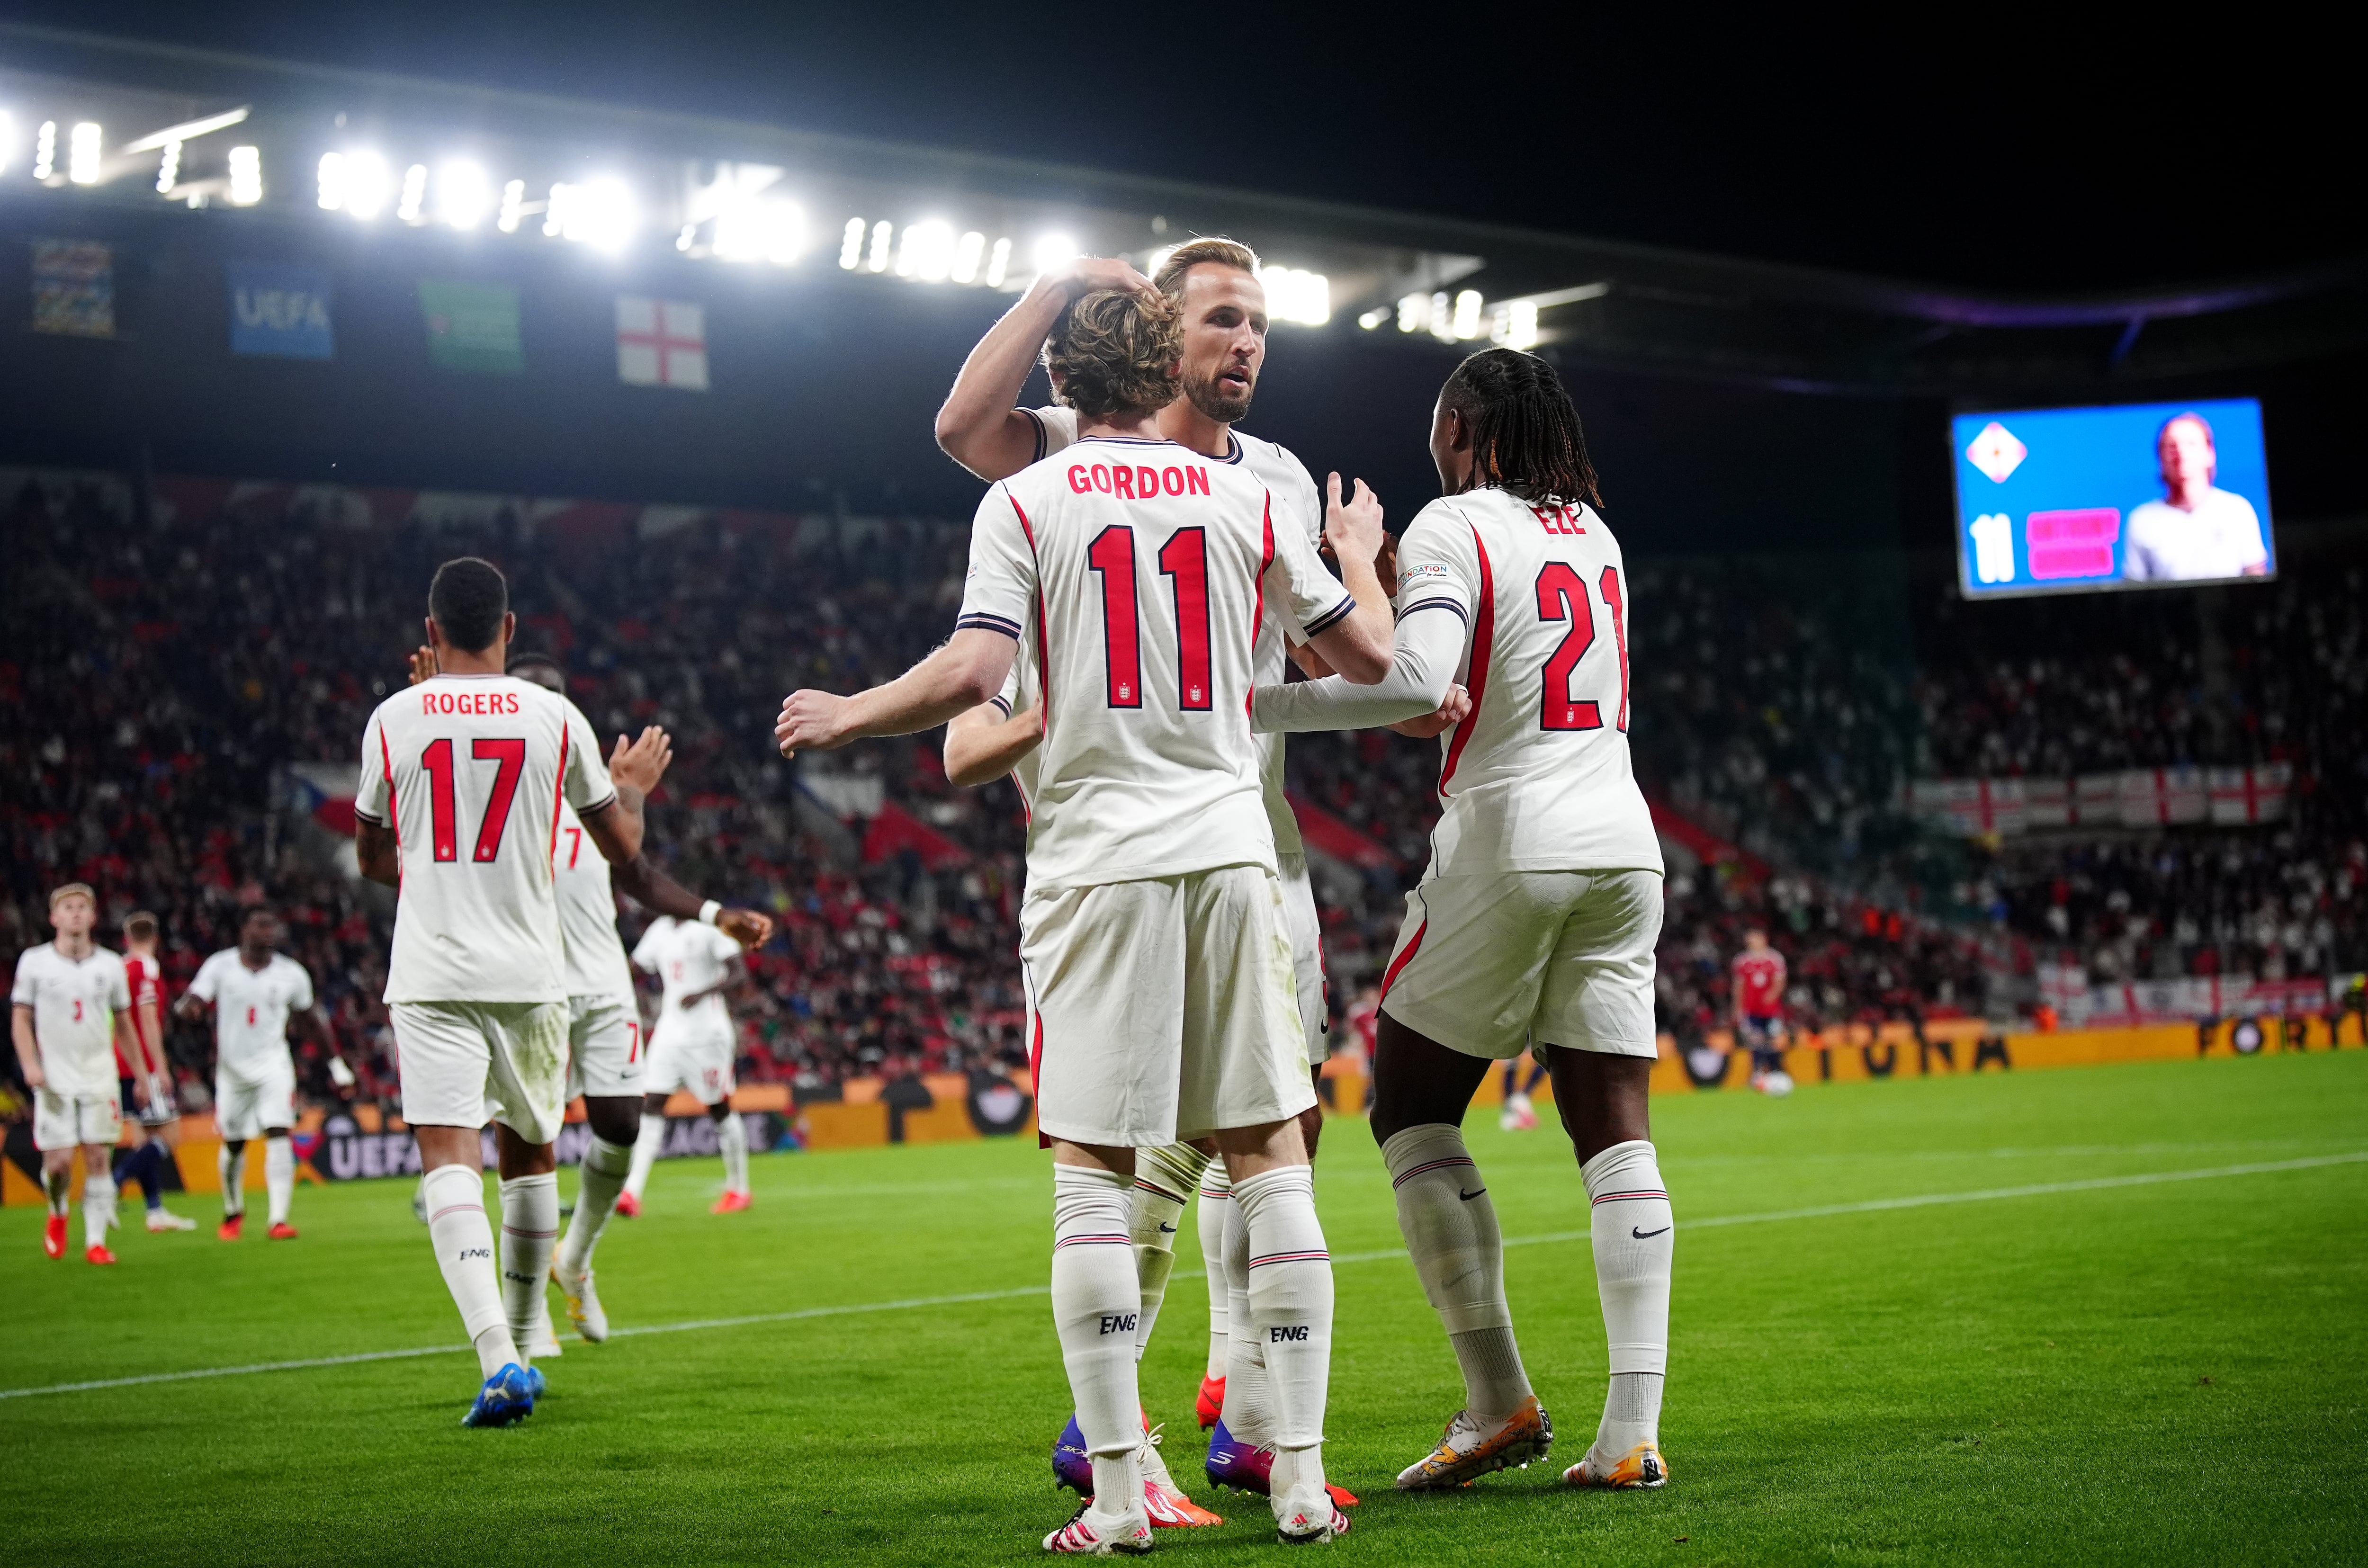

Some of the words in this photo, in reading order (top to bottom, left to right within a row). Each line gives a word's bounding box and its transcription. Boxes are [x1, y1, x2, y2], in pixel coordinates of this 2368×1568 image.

[235, 288, 331, 329] UEFA
[1067, 464, 1211, 500] GORDON
[1532, 505, 1587, 535] EZE
[1088, 524, 1213, 711] 11
[1535, 561, 1628, 734] 21
[423, 693, 519, 715] ROGERS
[422, 738, 525, 863] 17
[565, 827, 582, 869] 7
[628, 1022, 639, 1064] 7
[460, 1248, 490, 1261] ENG
[1100, 1314, 1137, 1335] ENG
[1270, 1326, 1309, 1343] ENG
